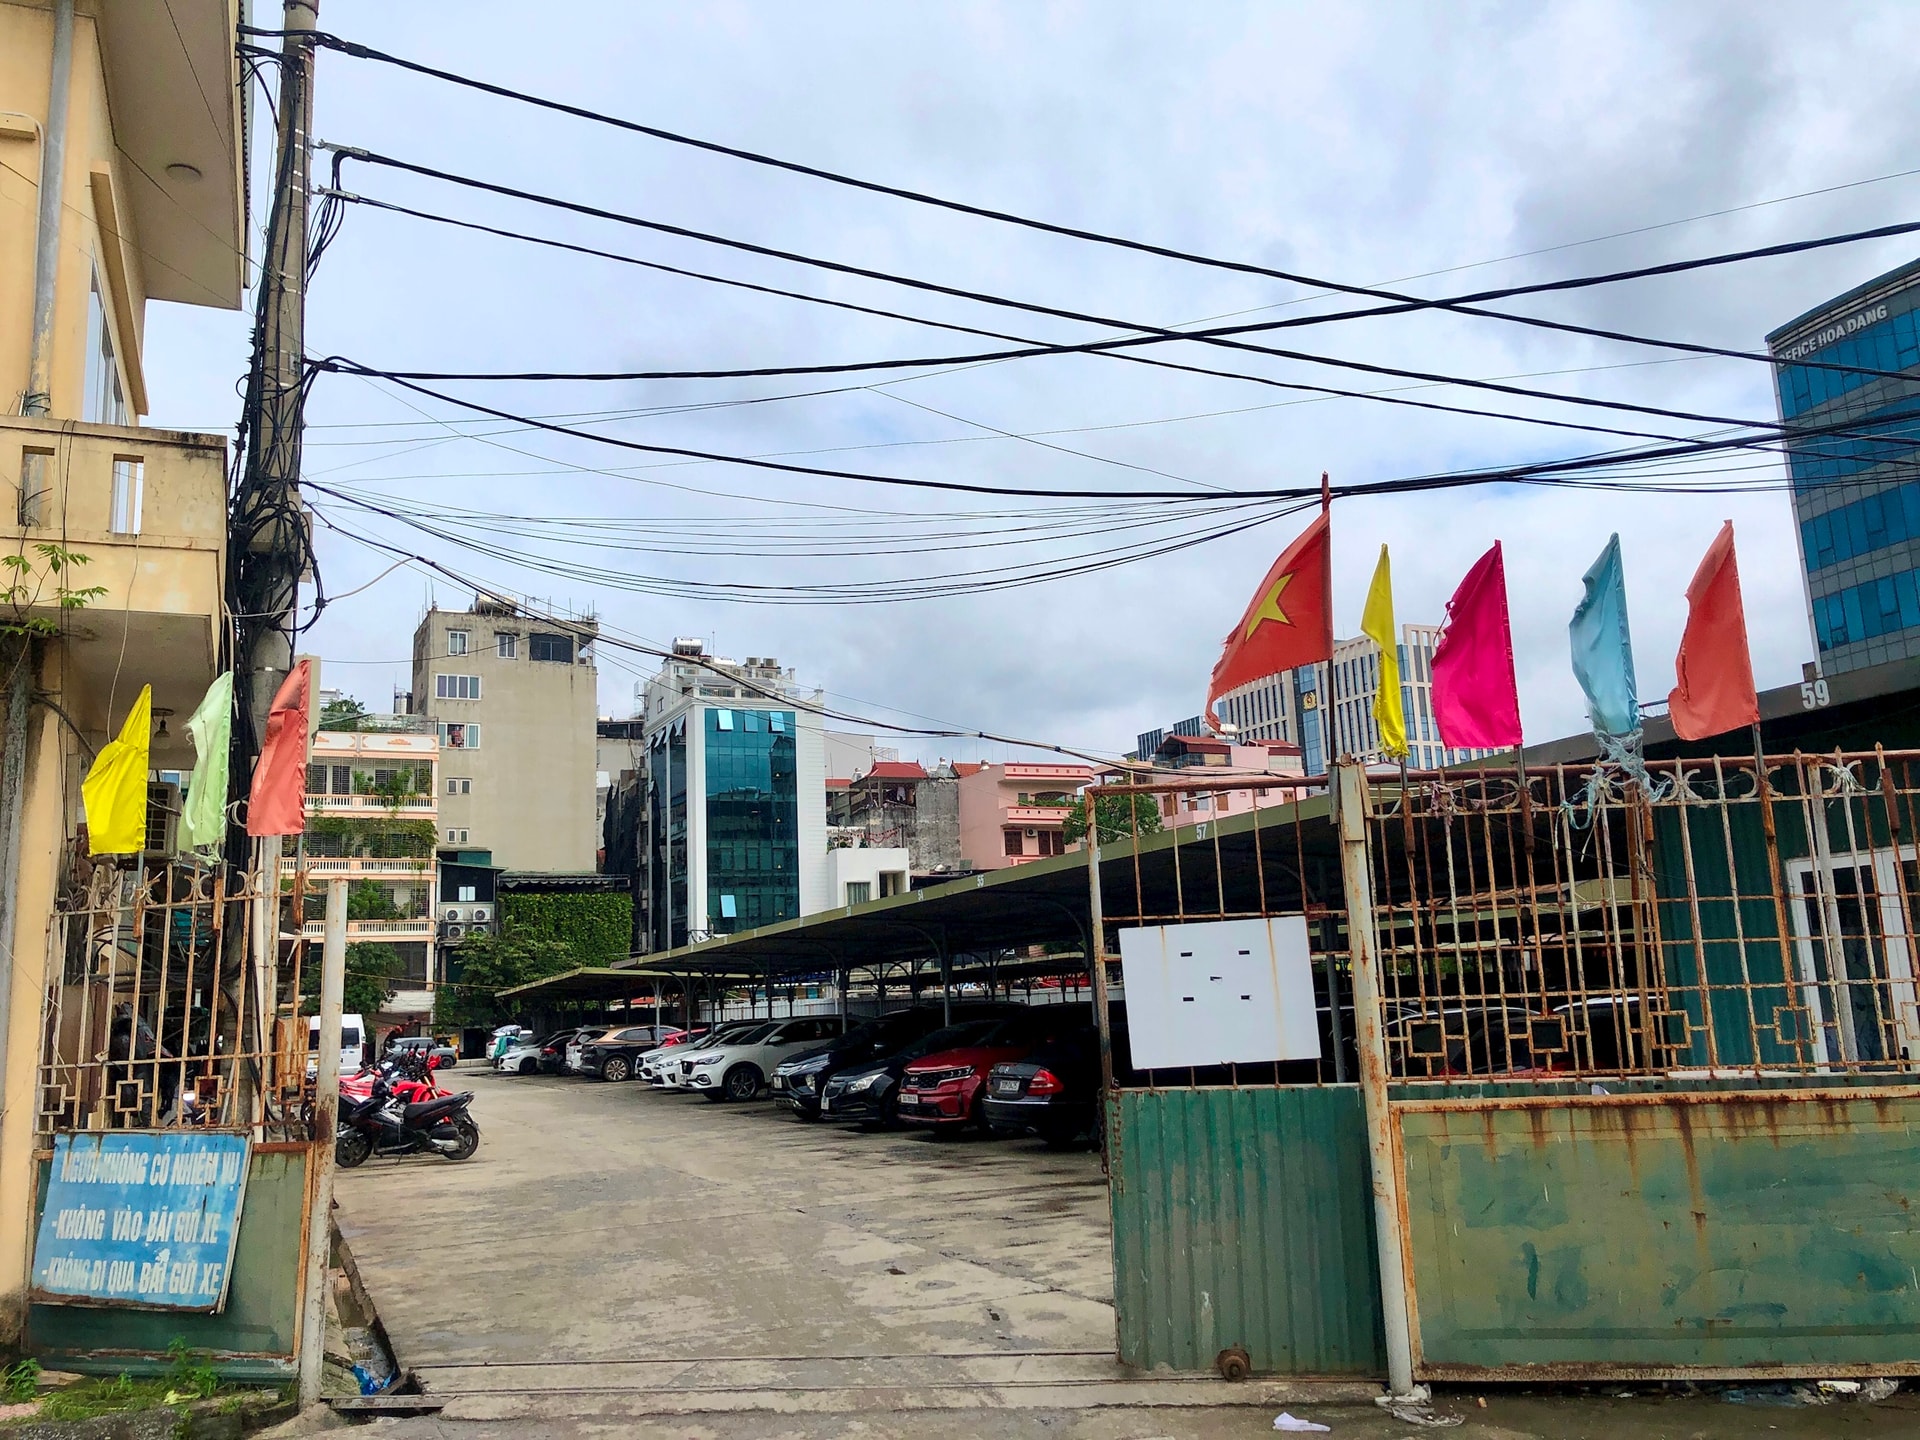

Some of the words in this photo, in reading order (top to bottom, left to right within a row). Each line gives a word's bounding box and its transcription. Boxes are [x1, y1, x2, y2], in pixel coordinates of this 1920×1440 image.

[1777, 337, 1818, 367] OFFICE
[1818, 324, 1846, 347] HOA
[1847, 304, 1888, 333] DANG
[1800, 679, 1830, 709] 59
[1196, 823, 1208, 840] 57
[976, 874, 985, 887] 55
[100, 1145, 149, 1184] KHÔNG
[149, 1146, 172, 1186] CÓ
[170, 1146, 220, 1192] NHIỆM
[221, 1151, 241, 1192] VỤ
[111, 1204, 143, 1242] VÀO
[200, 1212, 222, 1244] XE
[108, 1260, 136, 1295] QUA
[198, 1262, 223, 1295] XE
